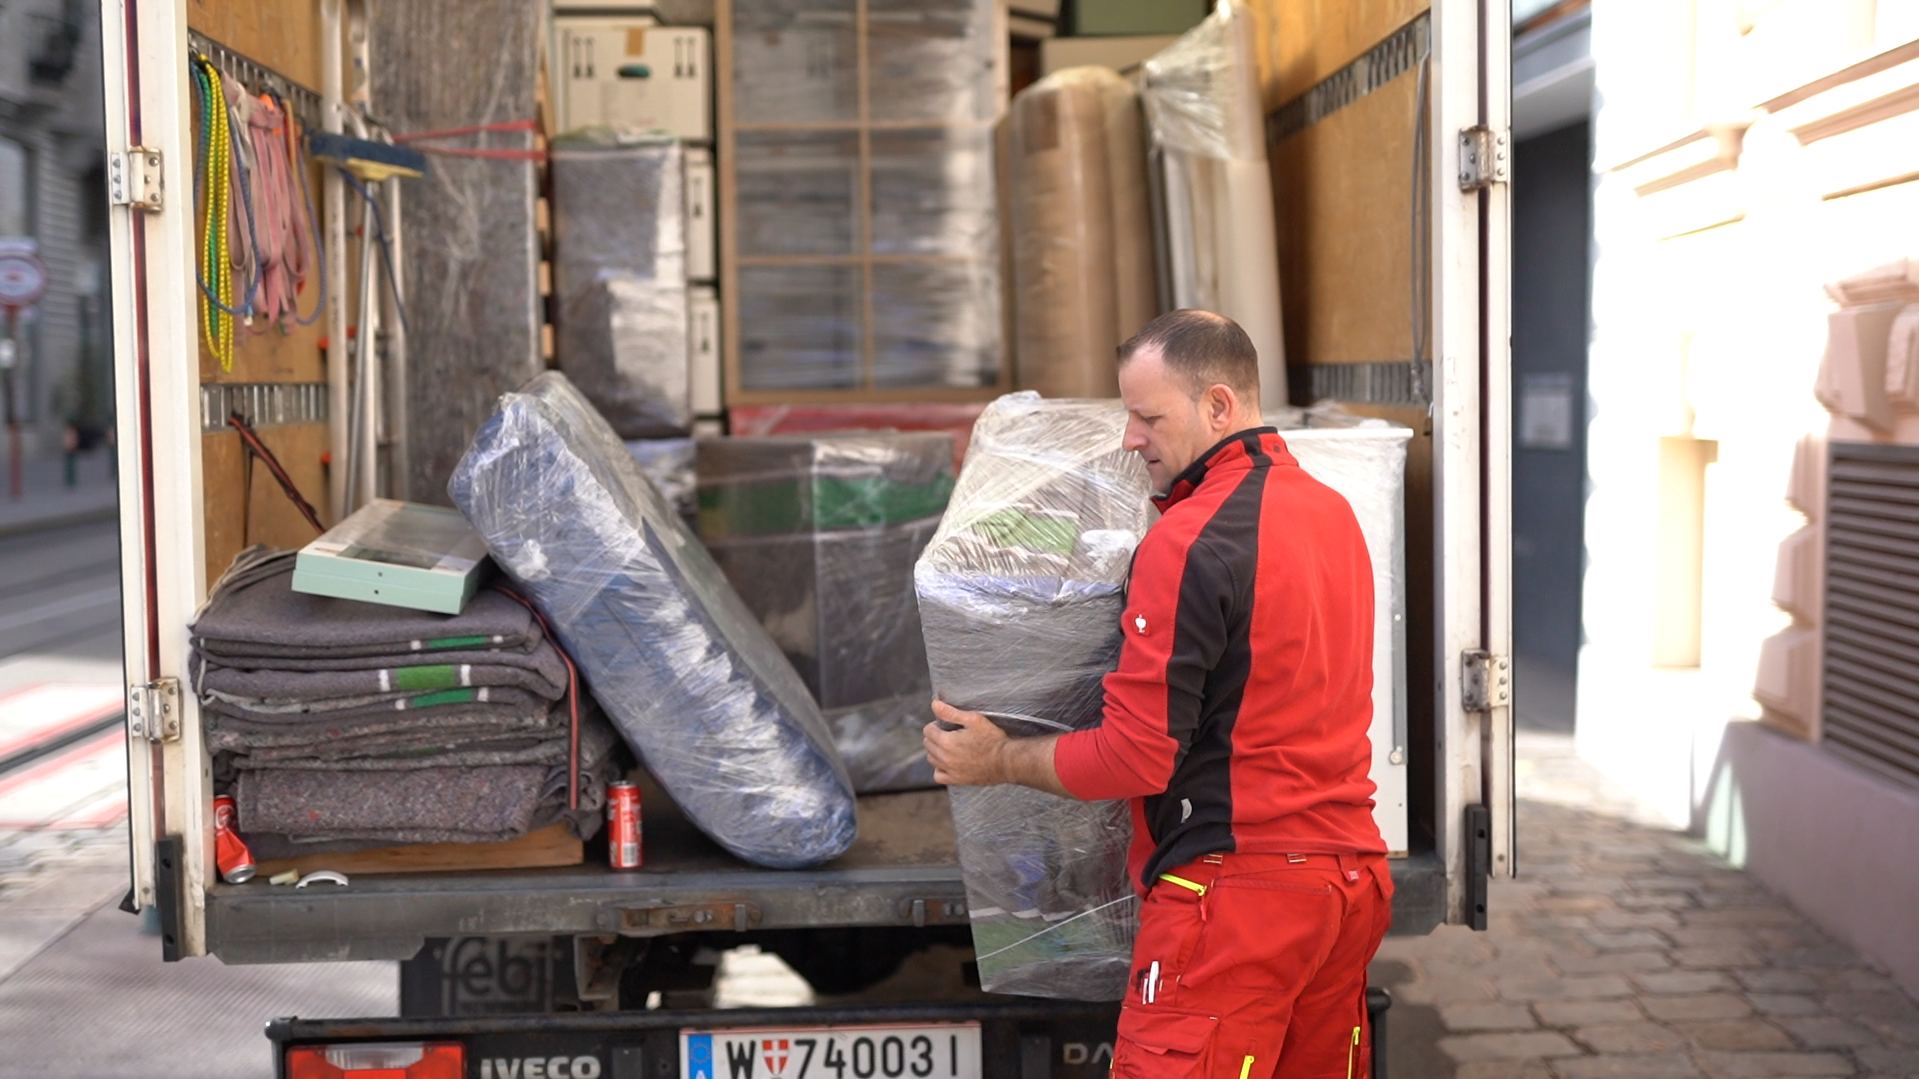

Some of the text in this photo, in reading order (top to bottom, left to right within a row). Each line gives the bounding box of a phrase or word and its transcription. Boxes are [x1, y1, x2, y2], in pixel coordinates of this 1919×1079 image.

[725, 1039, 756, 1079] W
[1062, 1042, 1114, 1065] DA
[480, 1055, 601, 1079] IVECO
